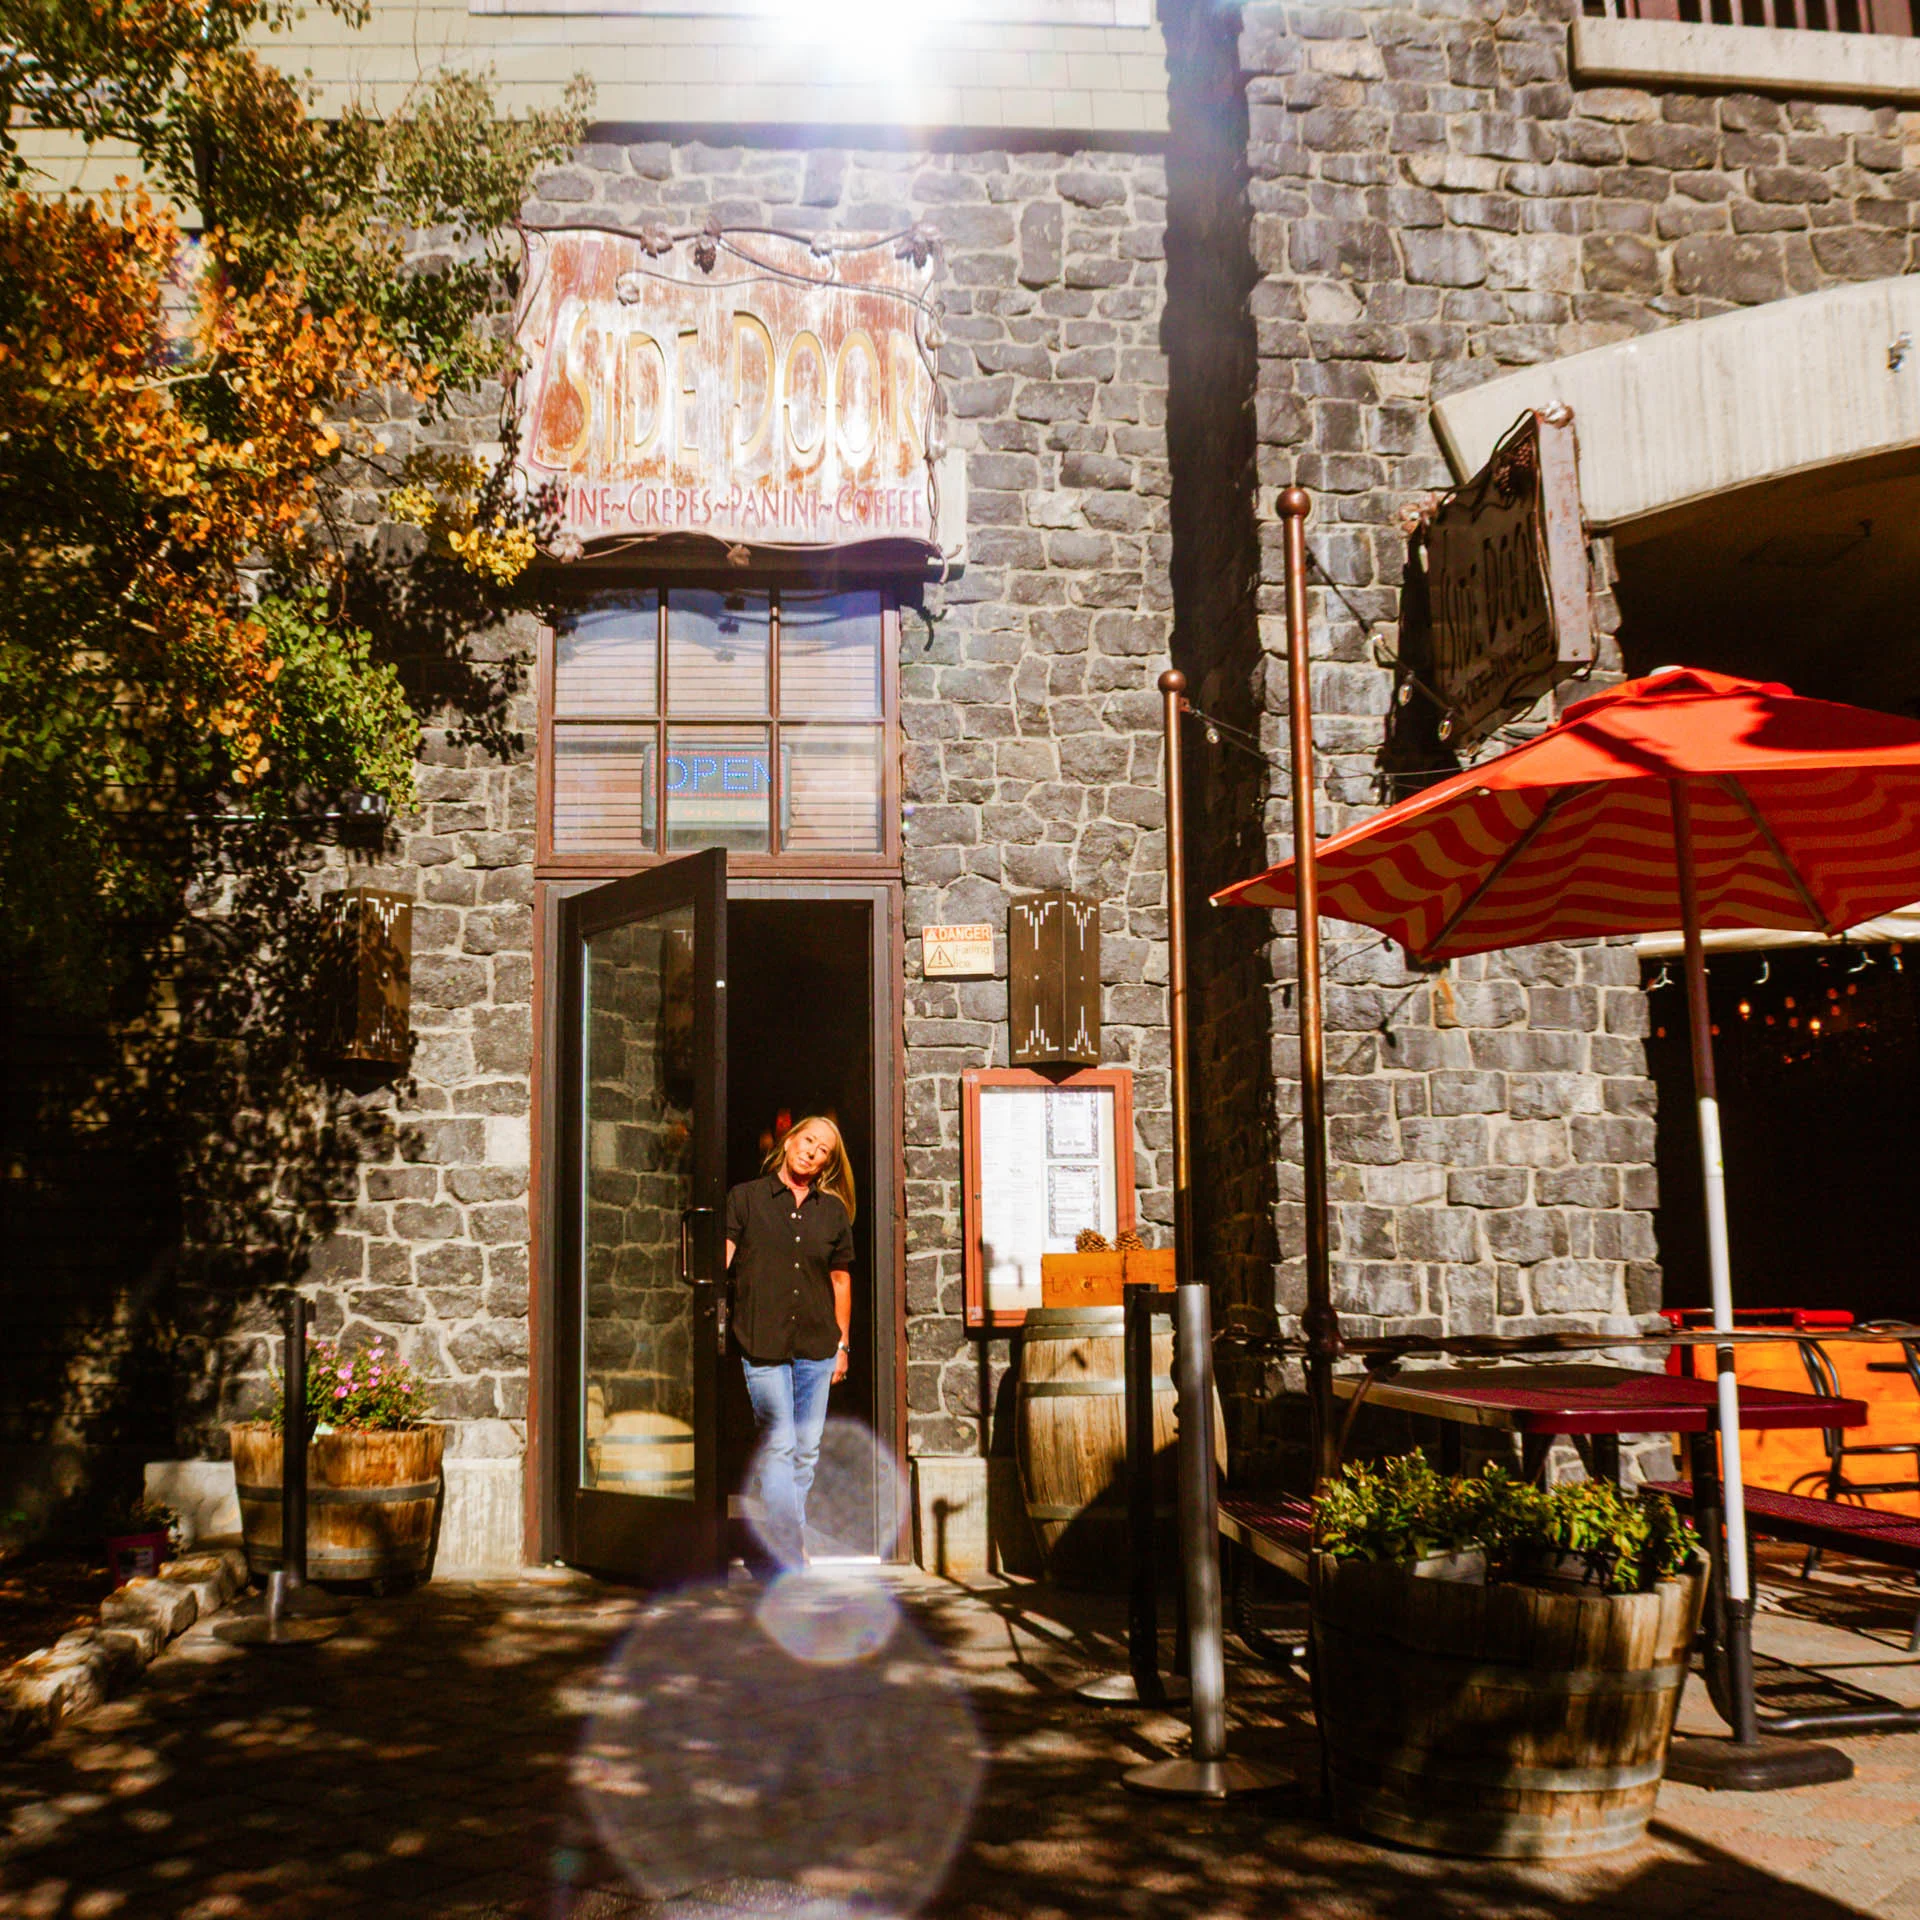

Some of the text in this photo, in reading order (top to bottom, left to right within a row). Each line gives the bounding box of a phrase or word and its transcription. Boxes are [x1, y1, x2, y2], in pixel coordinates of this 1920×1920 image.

[555, 303, 924, 473] SIDE DOOR
[940, 926, 990, 941] DANGER
